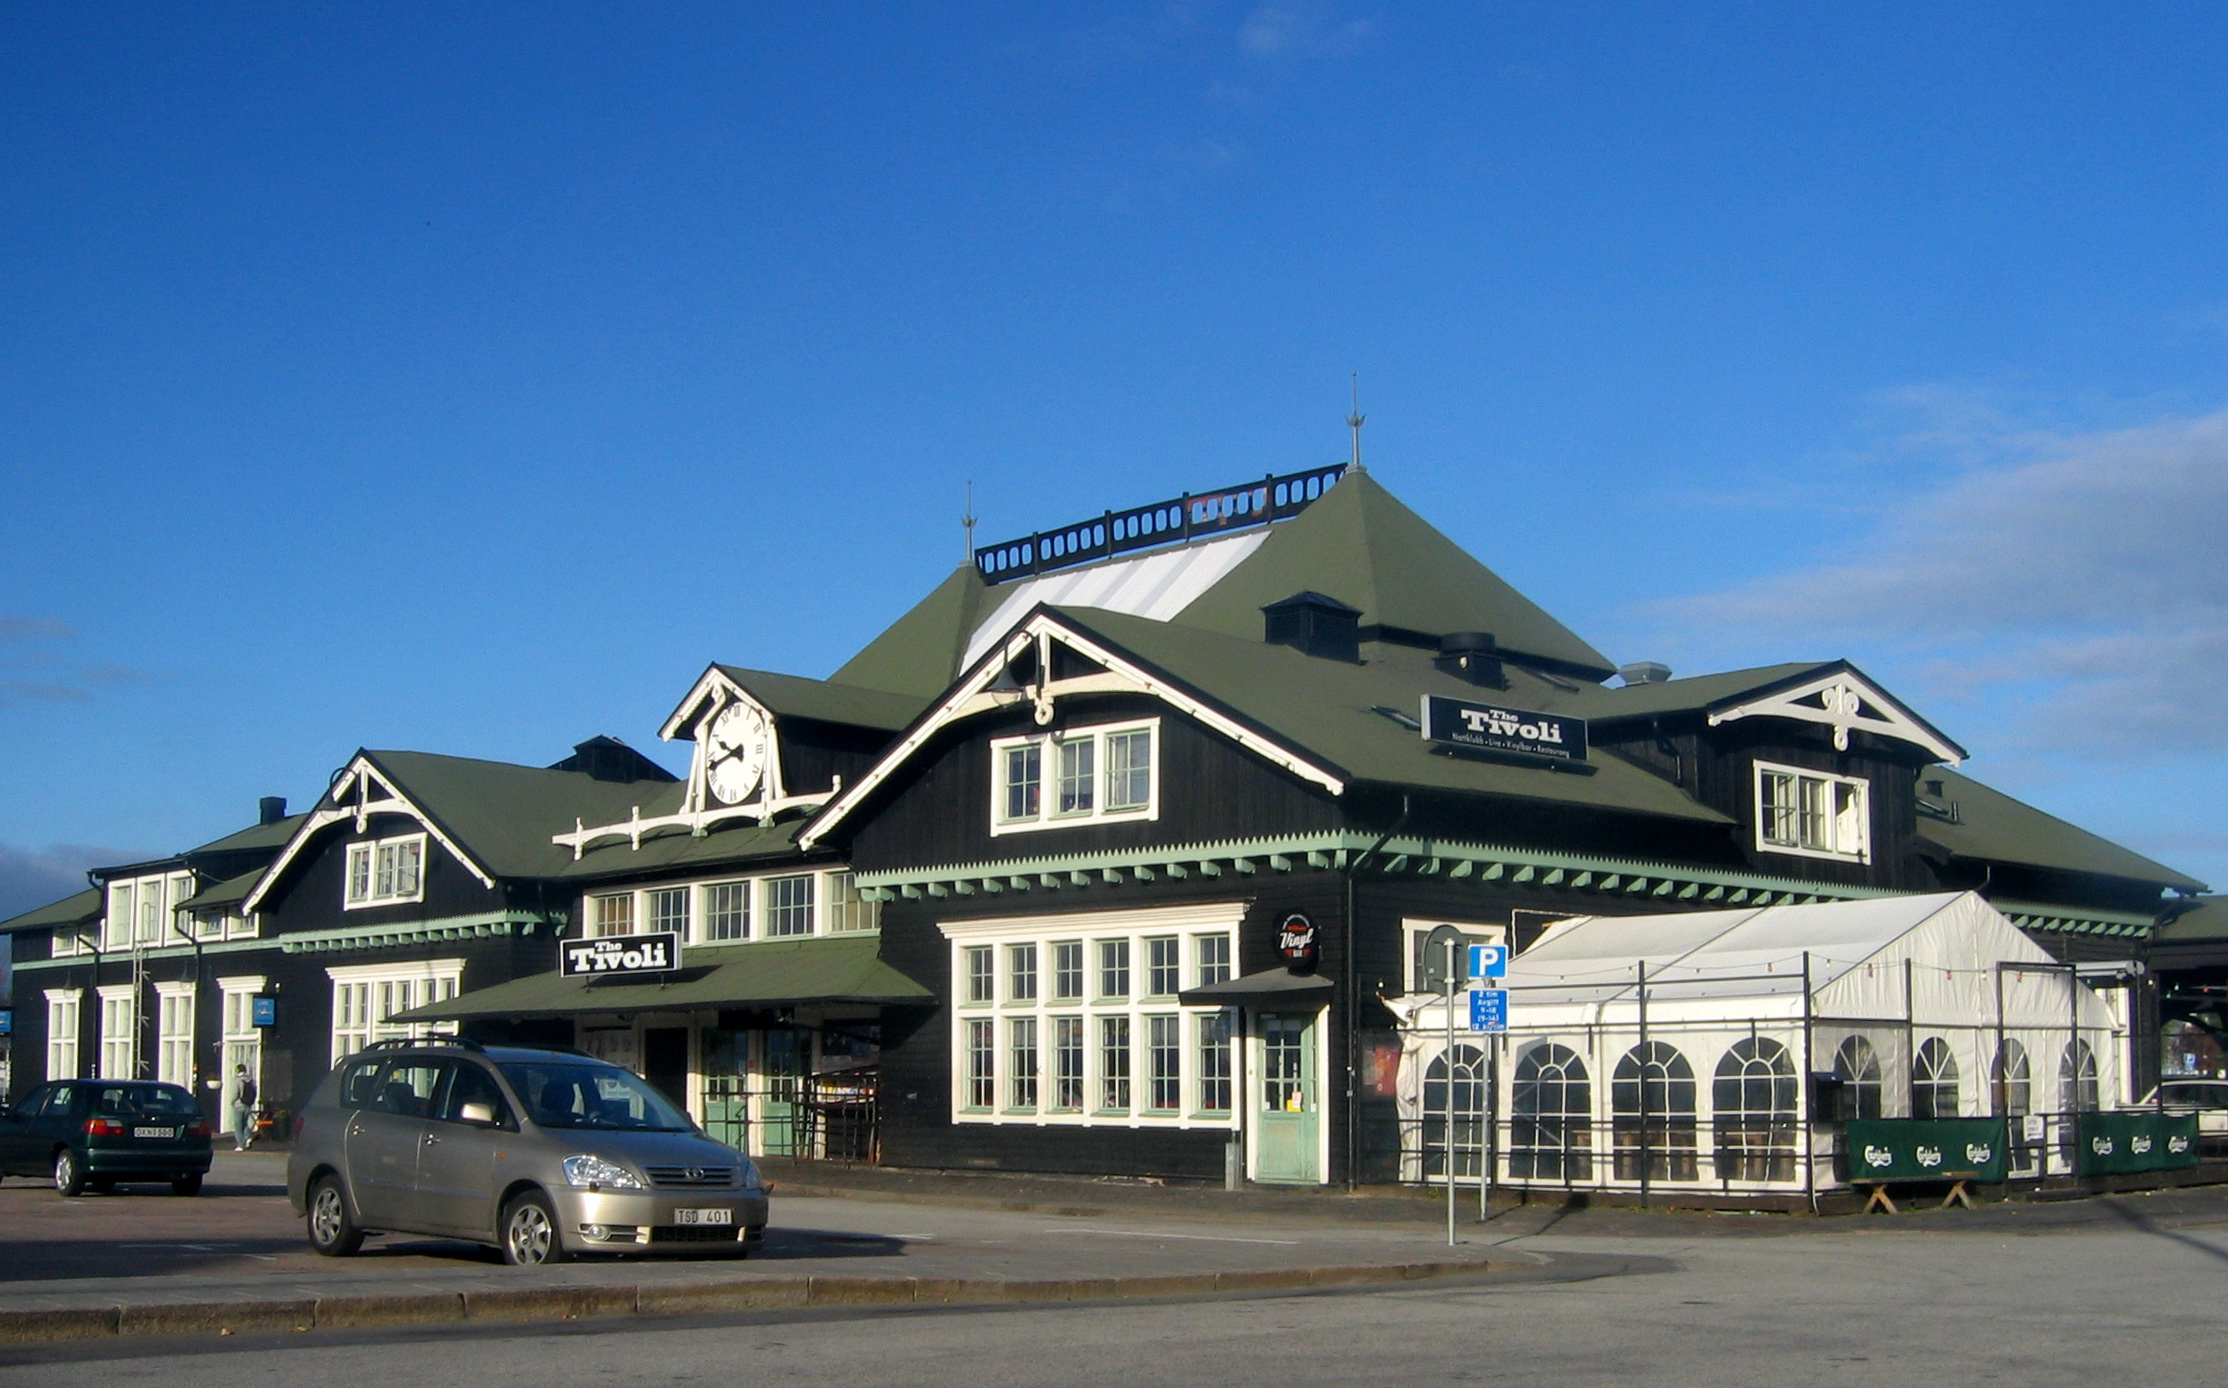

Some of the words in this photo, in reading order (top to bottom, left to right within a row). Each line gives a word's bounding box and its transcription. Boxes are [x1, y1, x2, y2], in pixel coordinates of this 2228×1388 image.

[1489, 709, 1519, 722] The
[1460, 709, 1563, 744] Tivoli
[595, 941, 622, 952] The
[1280, 928, 1314, 949] Vinyl
[569, 942, 667, 972] Tivoli
[1479, 948, 1499, 976] P
[678, 1210, 698, 1223] TSD
[706, 1210, 729, 1223] 401
